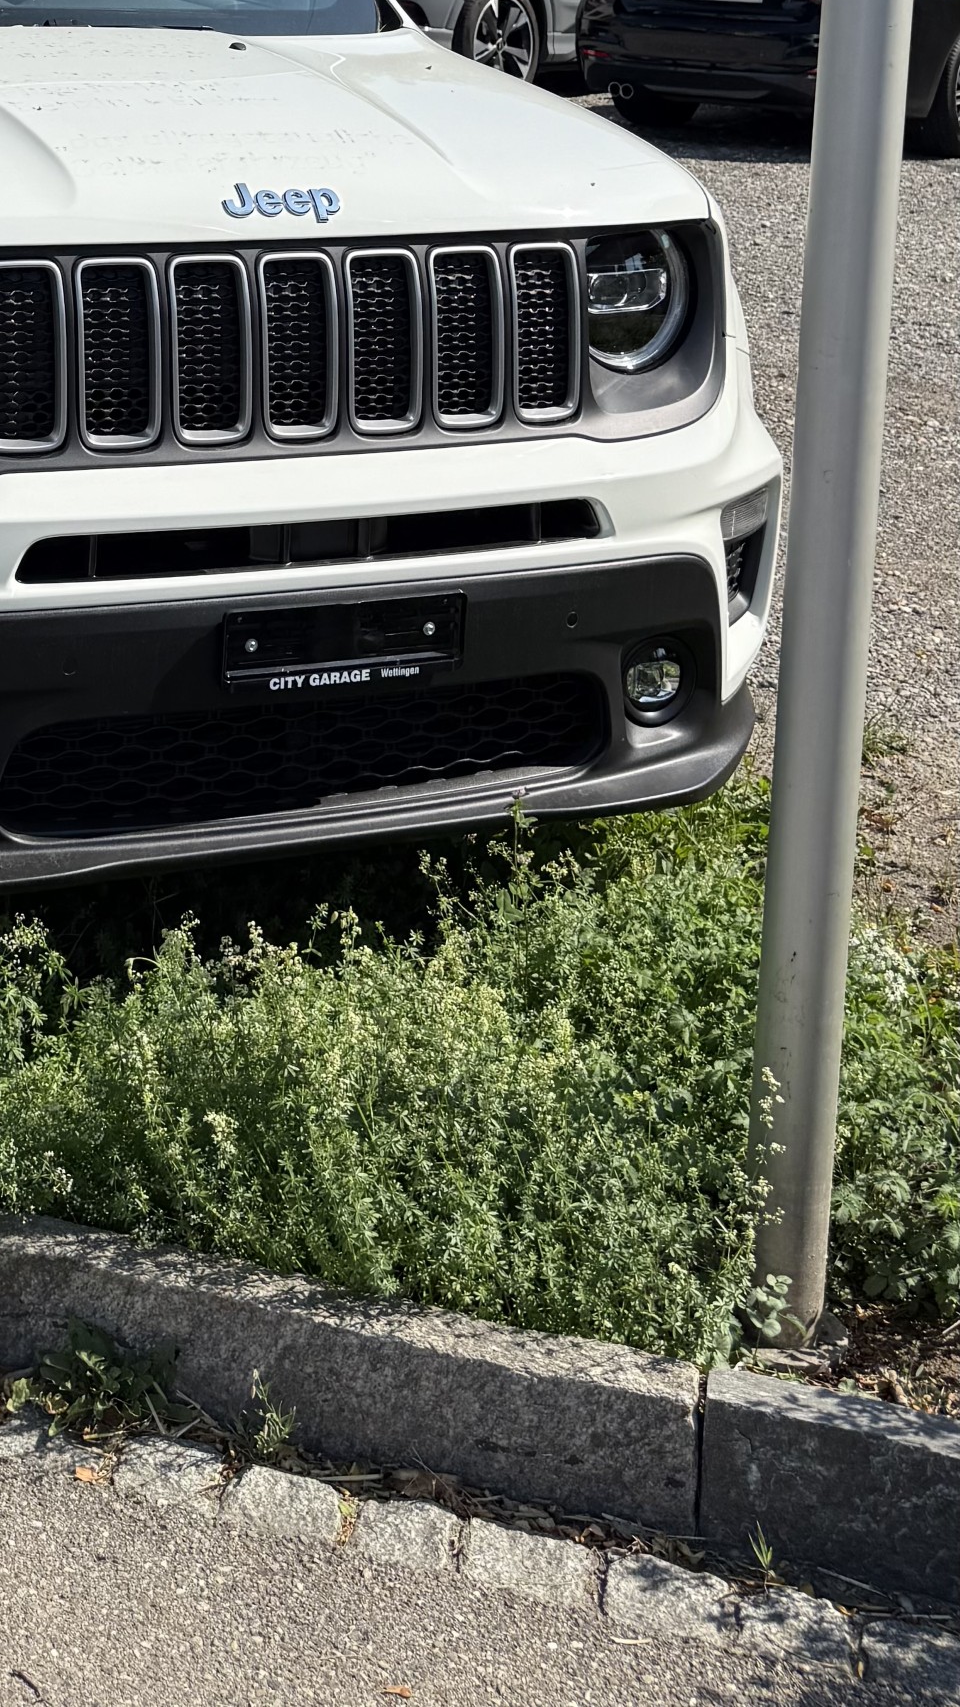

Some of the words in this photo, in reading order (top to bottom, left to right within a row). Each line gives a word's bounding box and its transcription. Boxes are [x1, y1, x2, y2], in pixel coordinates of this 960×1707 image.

[221, 182, 341, 224] Jeep
[269, 673, 306, 691] CITY
[309, 668, 371, 687] GARAGE
[380, 665, 420, 679] Wettingen
